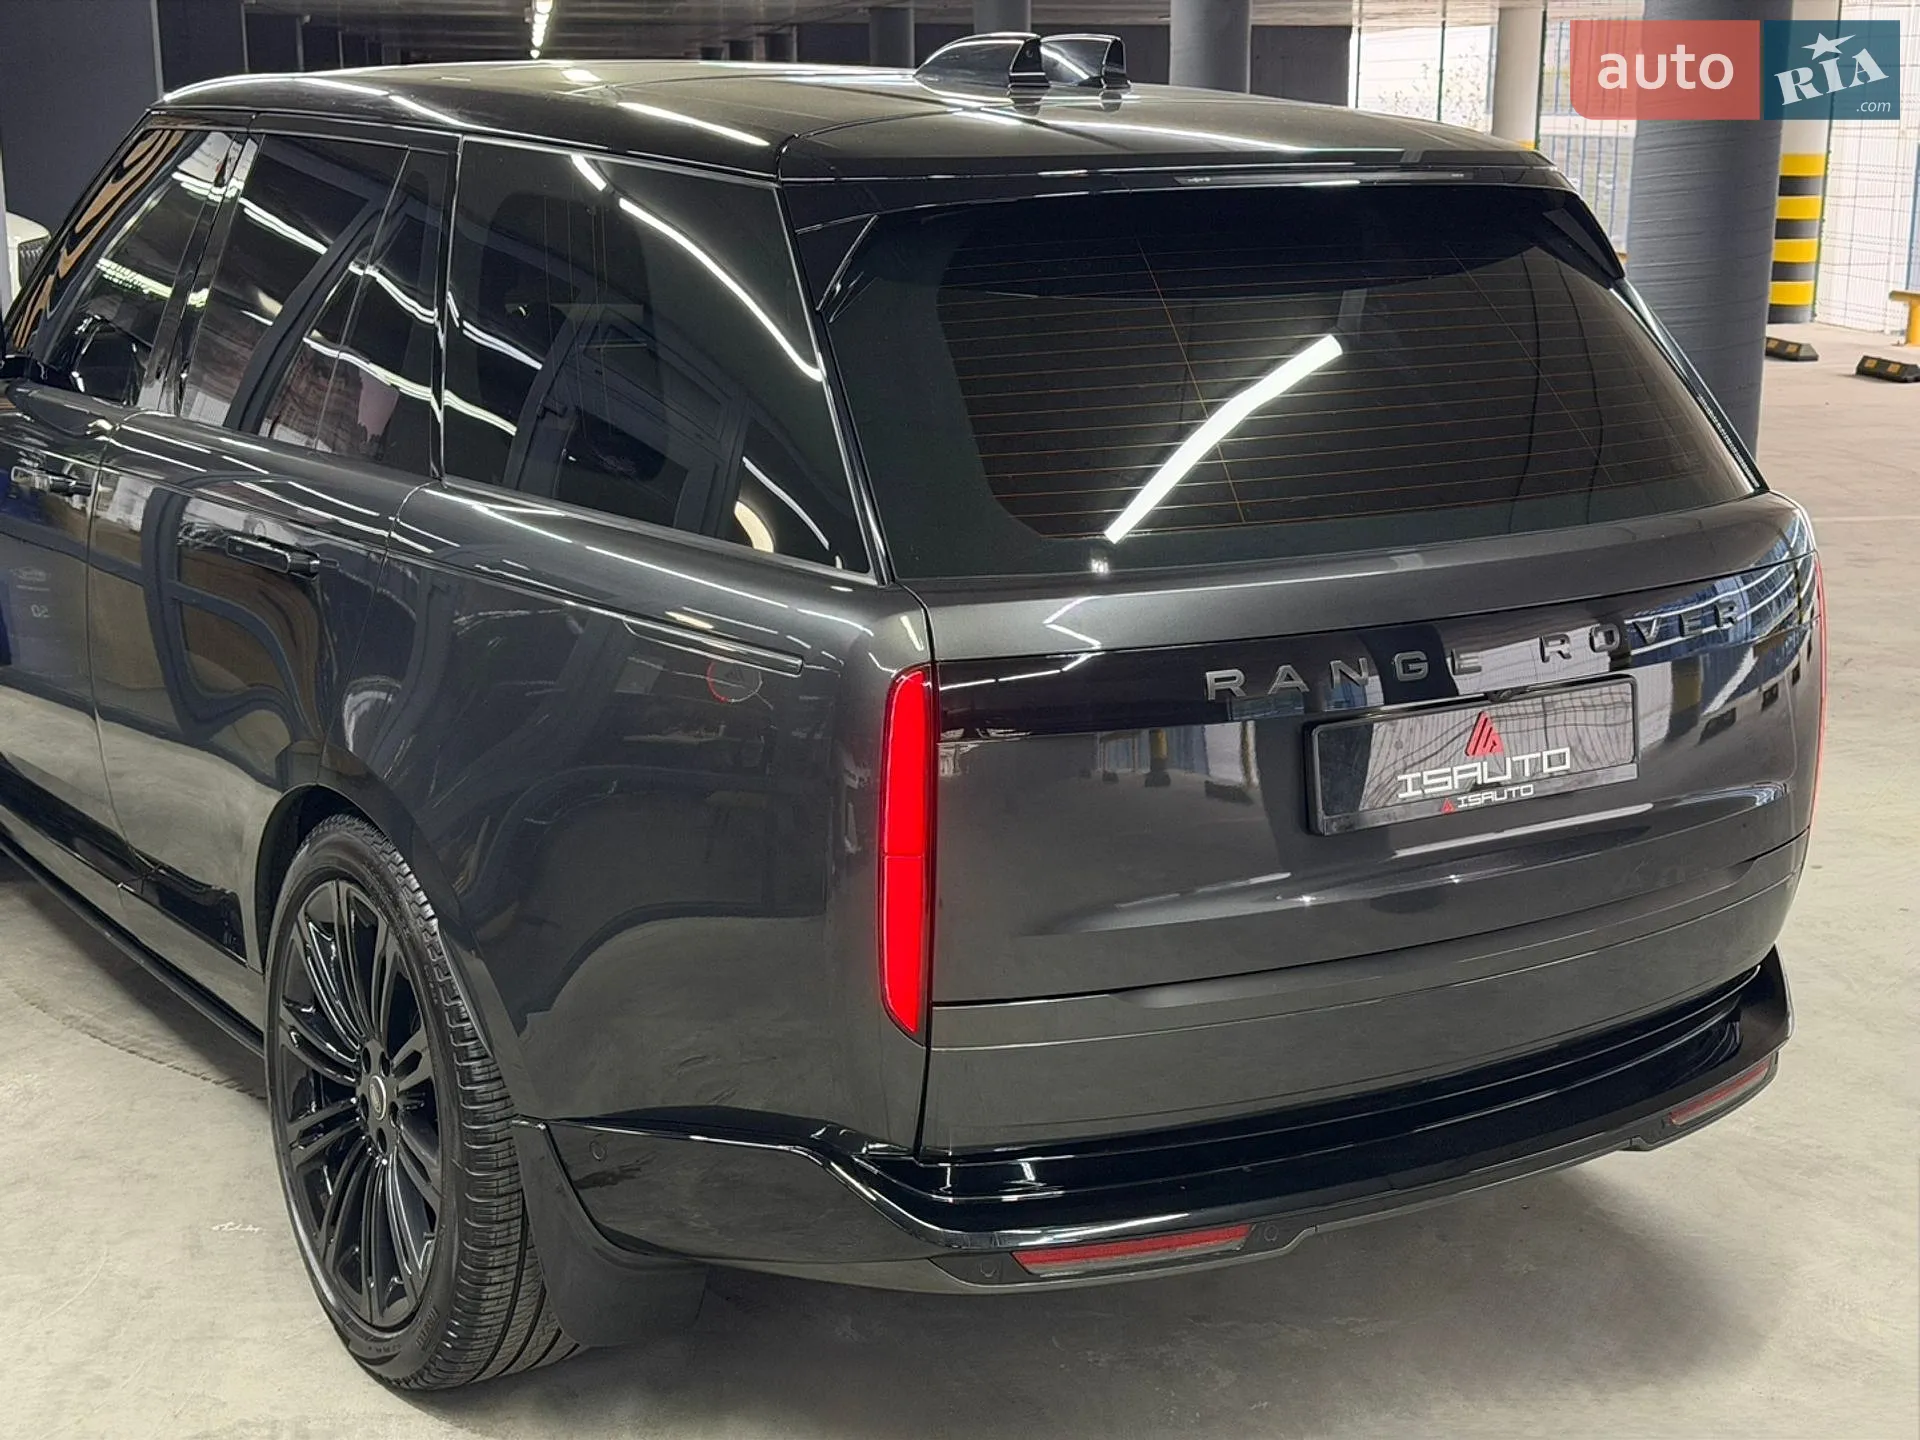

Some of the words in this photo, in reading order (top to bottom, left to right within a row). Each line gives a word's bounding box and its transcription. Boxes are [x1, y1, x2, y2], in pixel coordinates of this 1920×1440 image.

[1205, 647, 1483, 700] RANGE
[1539, 600, 1739, 663] ROVER
[1397, 747, 1571, 799] ISAUTO
[1457, 785, 1534, 808] ISAUTO
